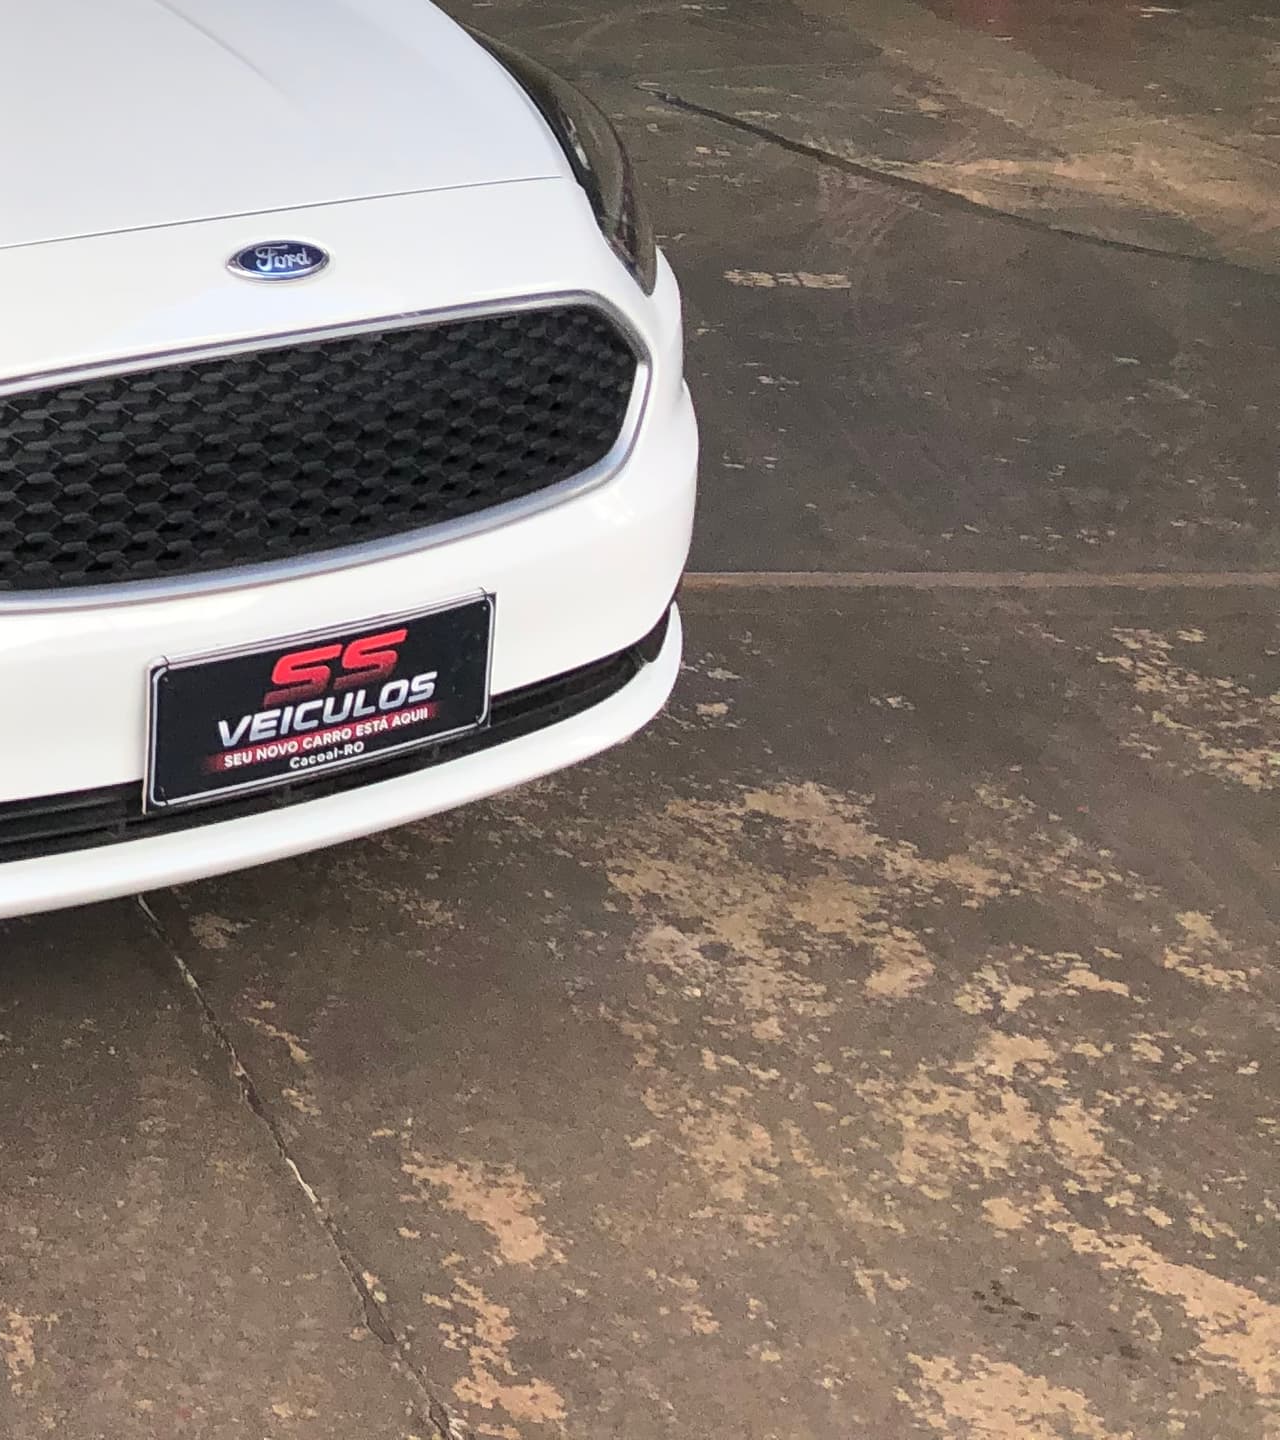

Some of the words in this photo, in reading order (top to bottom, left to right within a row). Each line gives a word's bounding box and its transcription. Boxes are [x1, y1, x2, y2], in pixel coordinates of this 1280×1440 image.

[255, 245, 312, 271] Ford
[263, 628, 409, 709] SS
[218, 671, 438, 748] VEICULOS
[224, 750, 253, 769] SEU
[256, 741, 298, 761] NOVO
[302, 727, 352, 750] CARRO
[356, 715, 389, 737] ESTÁ
[289, 741, 365, 769] Cacoal-RO
